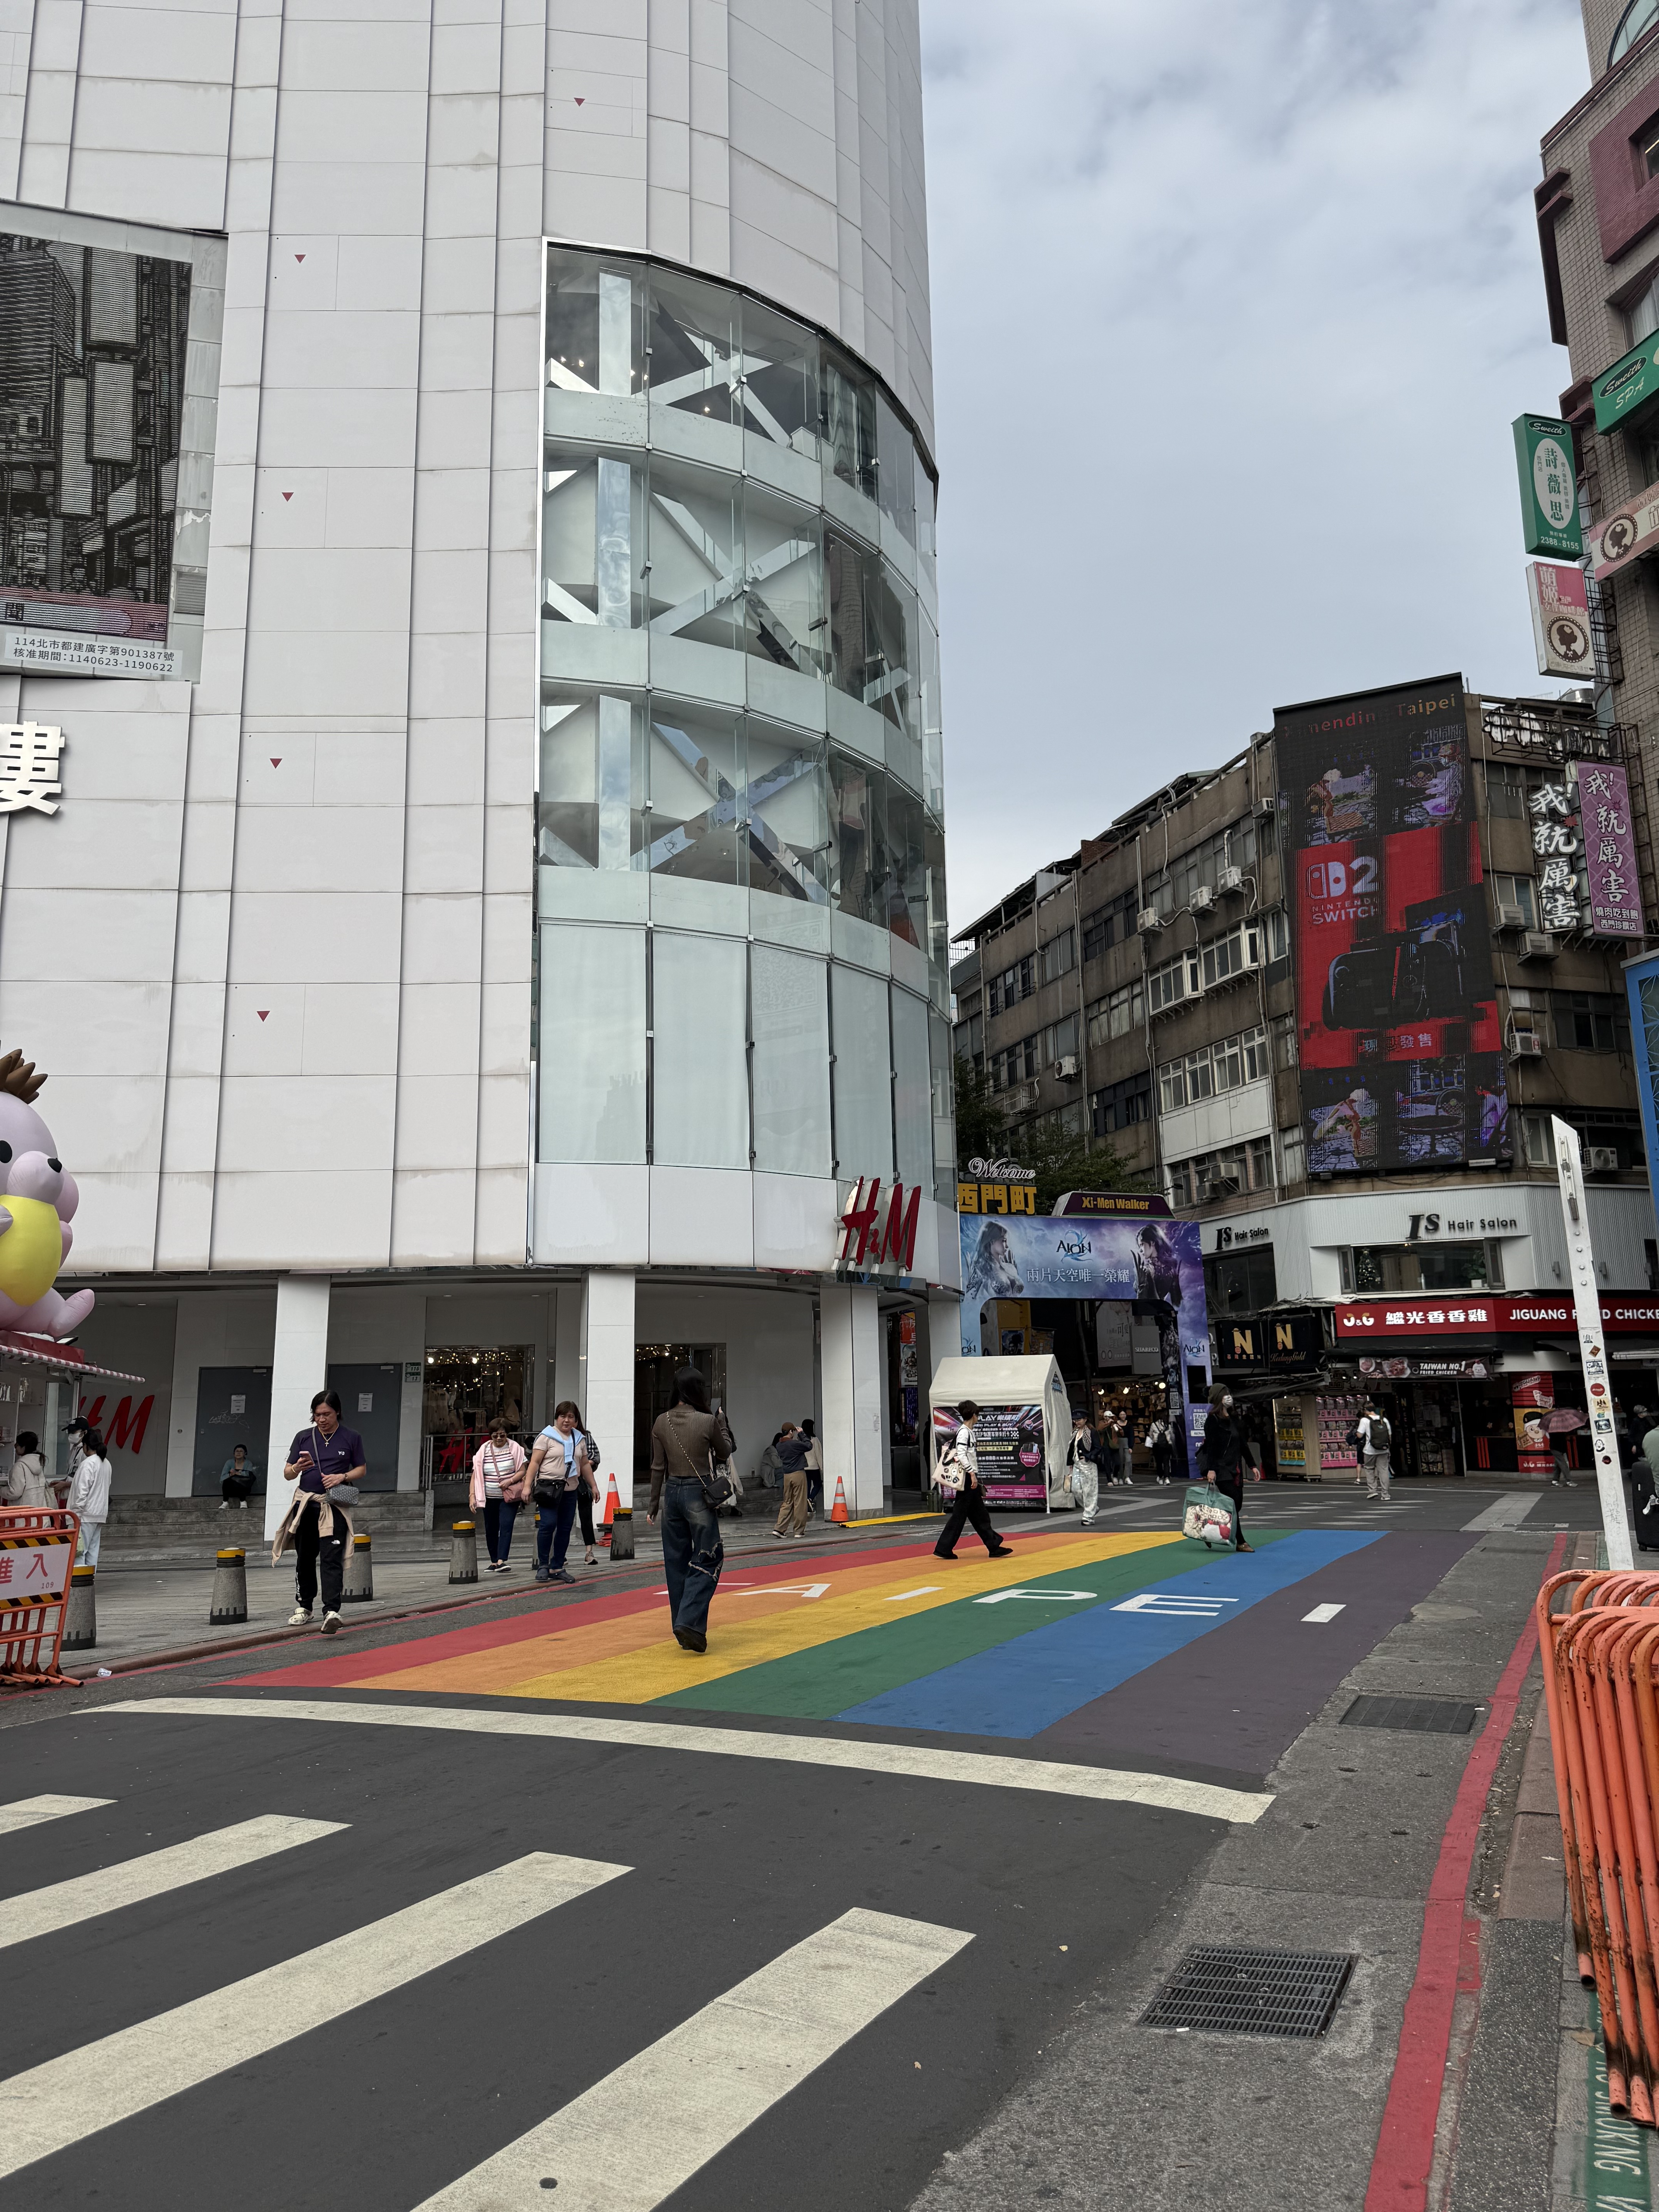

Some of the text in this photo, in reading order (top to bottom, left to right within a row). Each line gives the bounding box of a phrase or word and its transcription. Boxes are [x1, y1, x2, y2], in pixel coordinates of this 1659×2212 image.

[1615, 376, 1644, 409] SPA
[1544, 448, 1564, 522] 詩薇思
[1540, 536, 1579, 550] 2388-8155
[13, 647, 173, 672] 核准期間:1140623-1190622
[15, 637, 175, 661] 114北市都建廣字第901387號
[1395, 694, 1455, 717] Taipei
[968, 1157, 1036, 1179] Welcome
[957, 1183, 1037, 1215] 西門町
[1082, 1197, 1150, 1210] Xi-Men Walker
[836, 1175, 921, 1272] H&M
[1235, 1230, 1248, 1240] Hair
[1249, 1227, 1269, 1238] Salon
[1405, 1213, 1517, 1240] IS Hair Salon
[1056, 1240, 1092, 1254] AION
[1027, 1267, 1130, 1283] 兩片天空唯一榮耀
[1510, 1309, 1566, 1320] JIGUANG
[1183, 1344, 1205, 1353] AION
